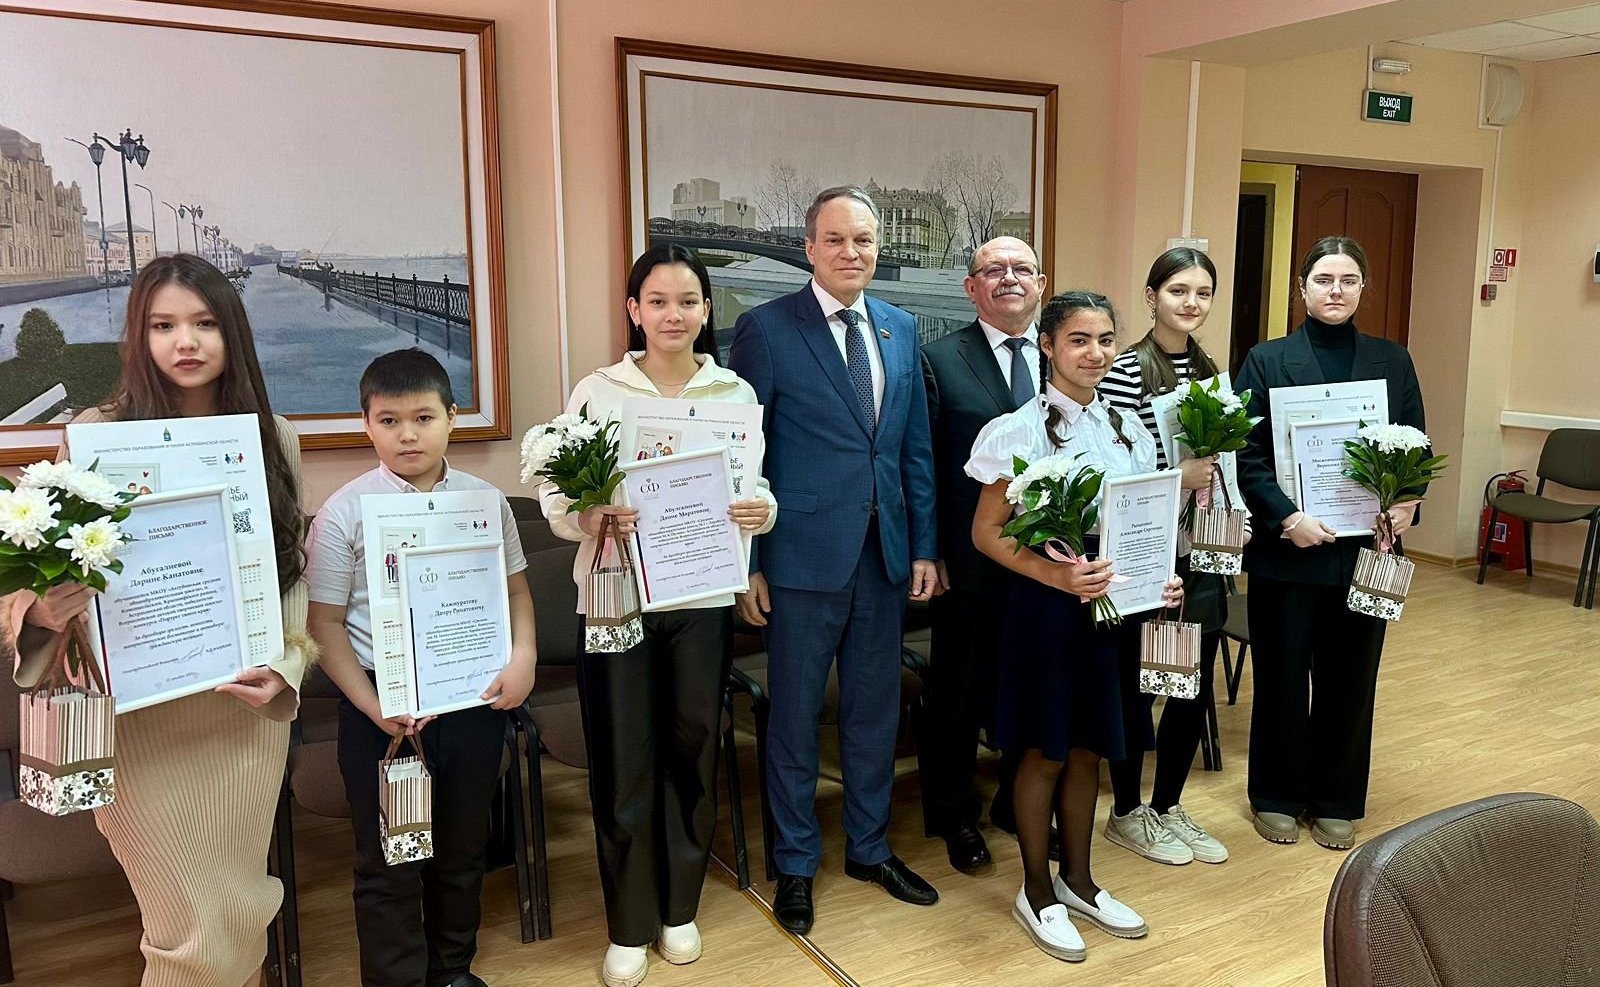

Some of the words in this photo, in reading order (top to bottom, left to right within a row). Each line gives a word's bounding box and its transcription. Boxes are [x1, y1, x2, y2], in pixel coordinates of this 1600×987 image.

[1379, 97, 1400, 110] ВЫХОД
[1383, 109, 1396, 118] EXIT
[148, 519, 208, 534] БЛАГОДАРСТВЕННОЕ
[130, 576, 161, 588] Дарине
[162, 567, 204, 580] Канатовне
